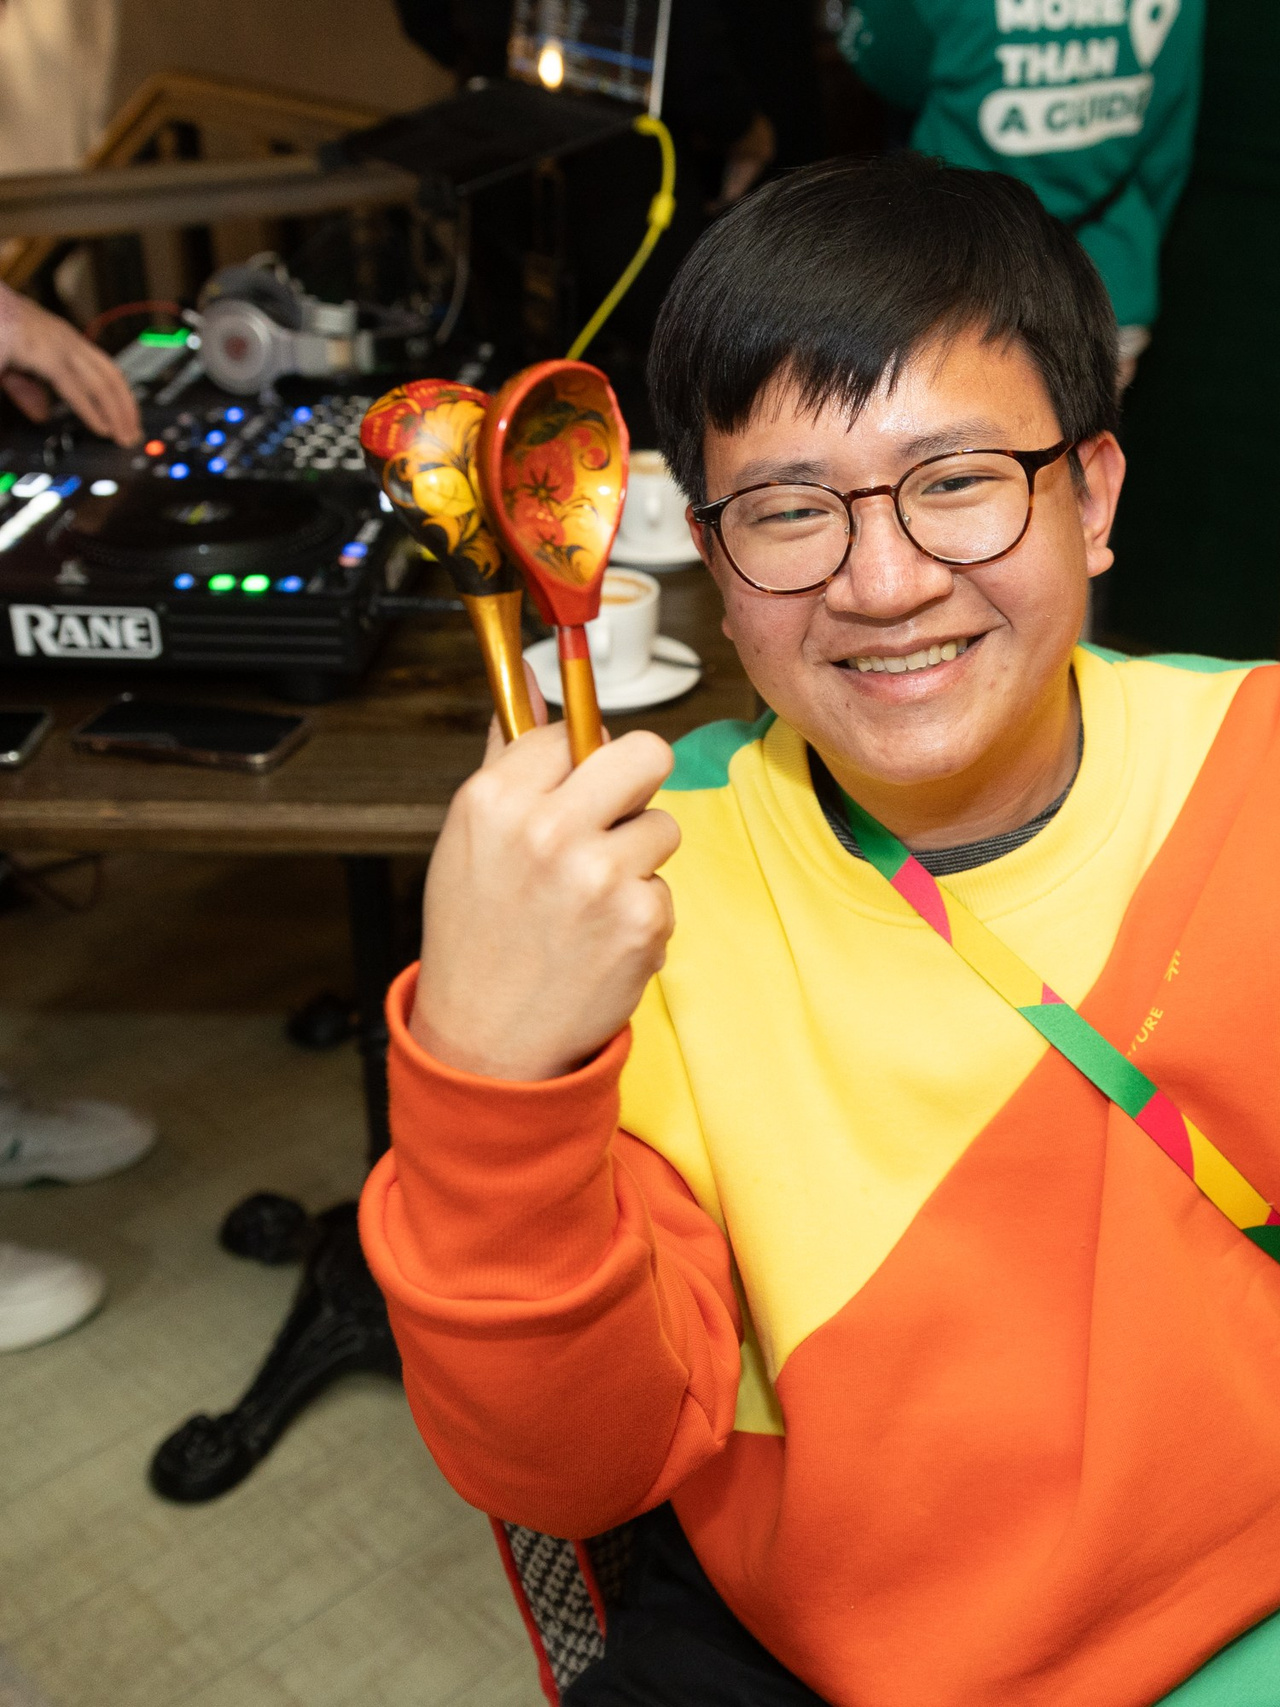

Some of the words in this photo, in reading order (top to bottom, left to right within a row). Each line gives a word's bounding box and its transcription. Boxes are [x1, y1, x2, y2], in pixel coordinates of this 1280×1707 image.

[995, 0, 1126, 33] MORE
[995, 36, 1118, 86] THAN
[998, 104, 1028, 135] A
[9, 603, 152, 657] RANE
